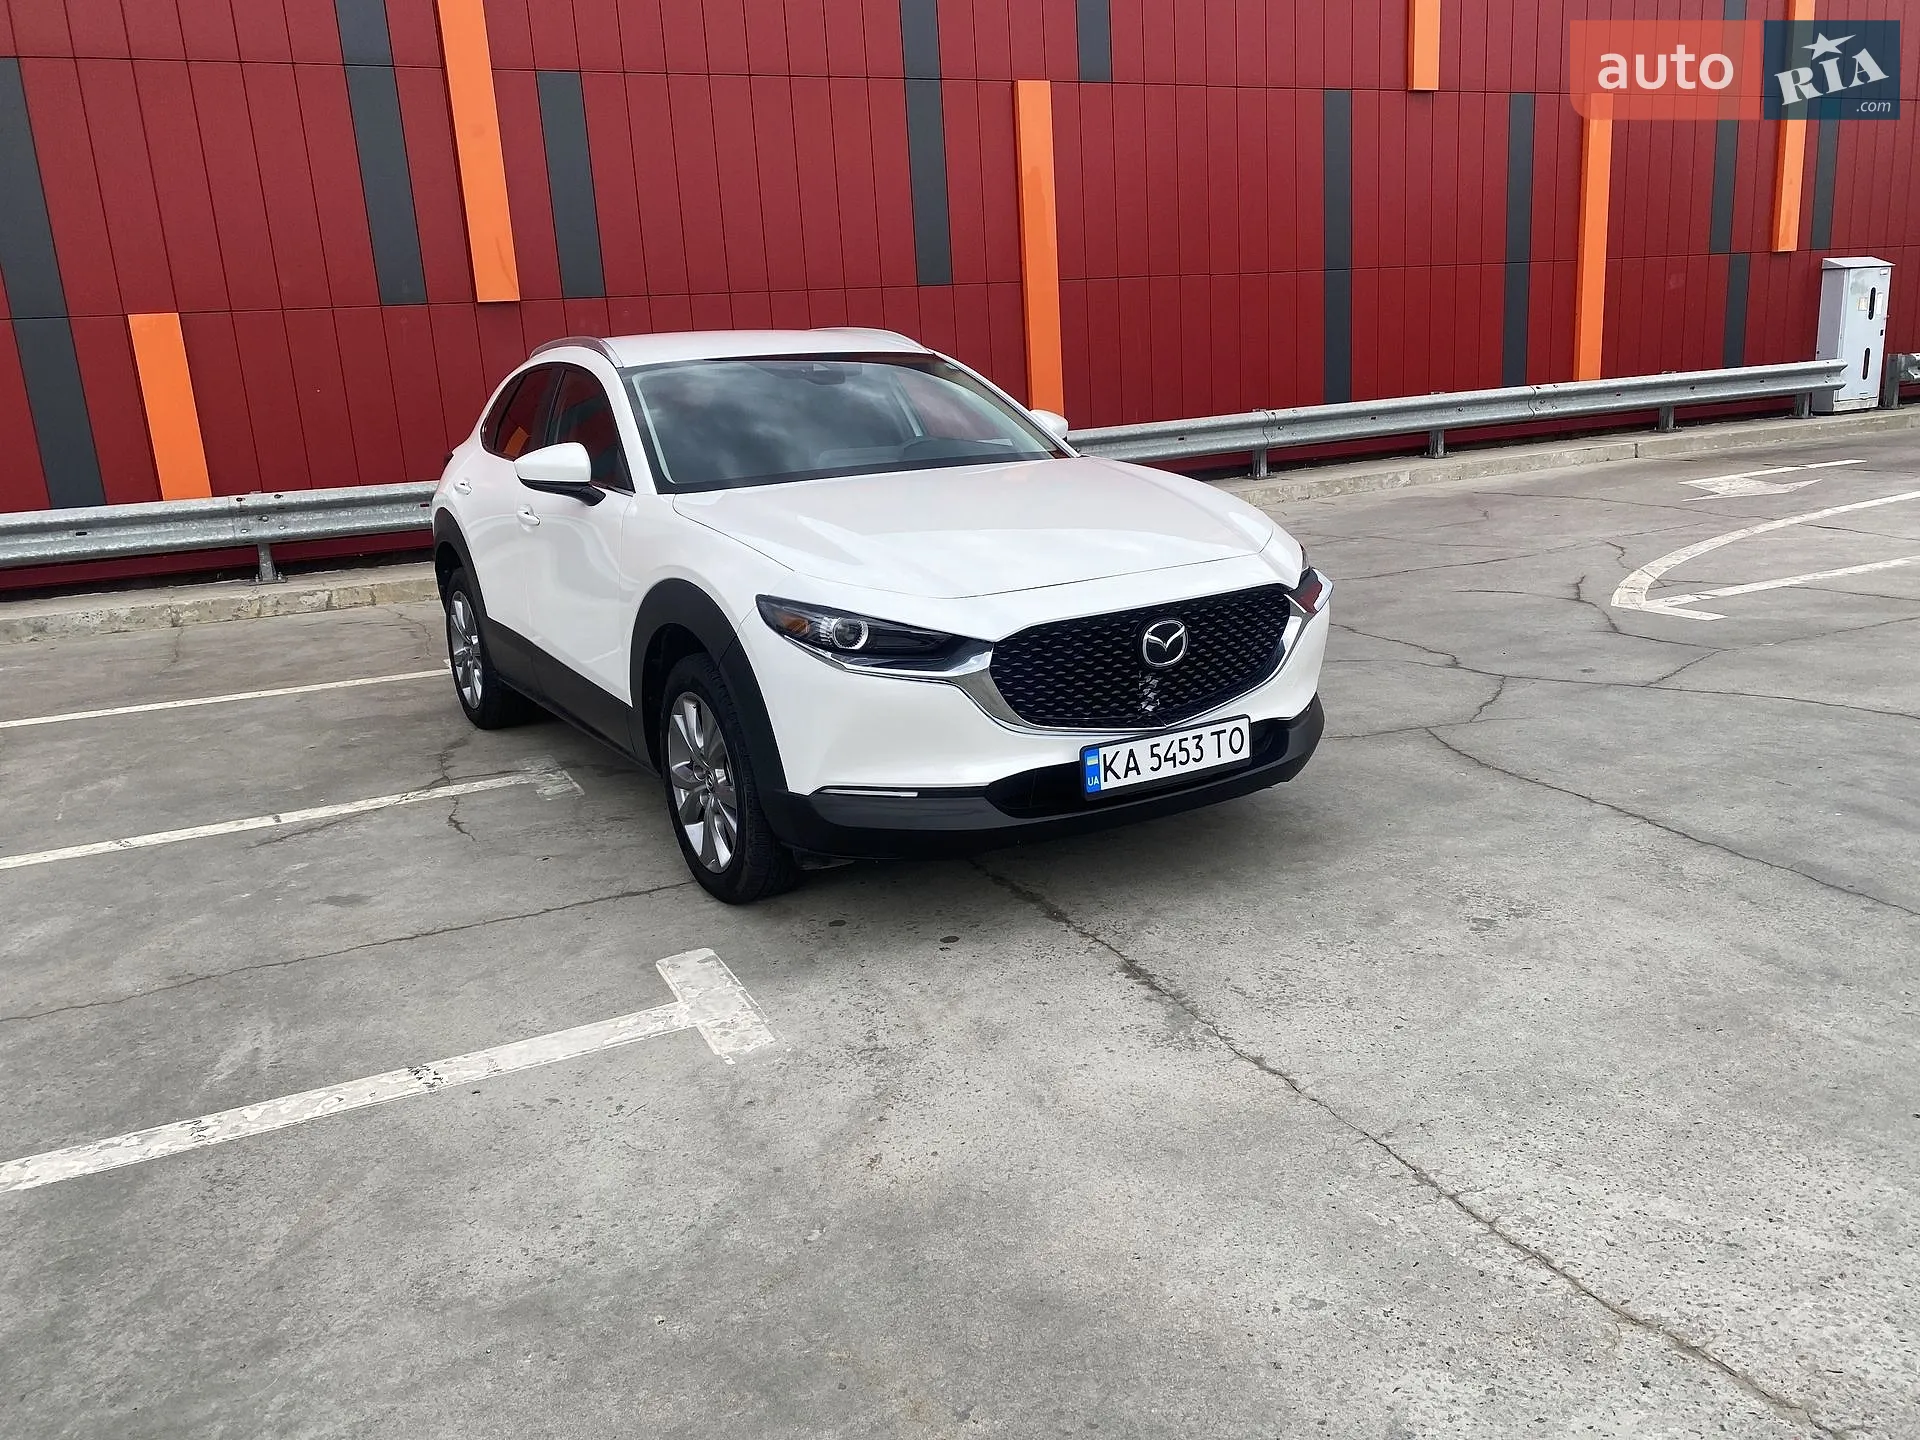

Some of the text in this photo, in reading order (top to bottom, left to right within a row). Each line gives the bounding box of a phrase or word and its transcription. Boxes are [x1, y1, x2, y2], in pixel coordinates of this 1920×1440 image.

[1102, 726, 1245, 783] KA 5453 TO
[1087, 776, 1100, 786] UA
